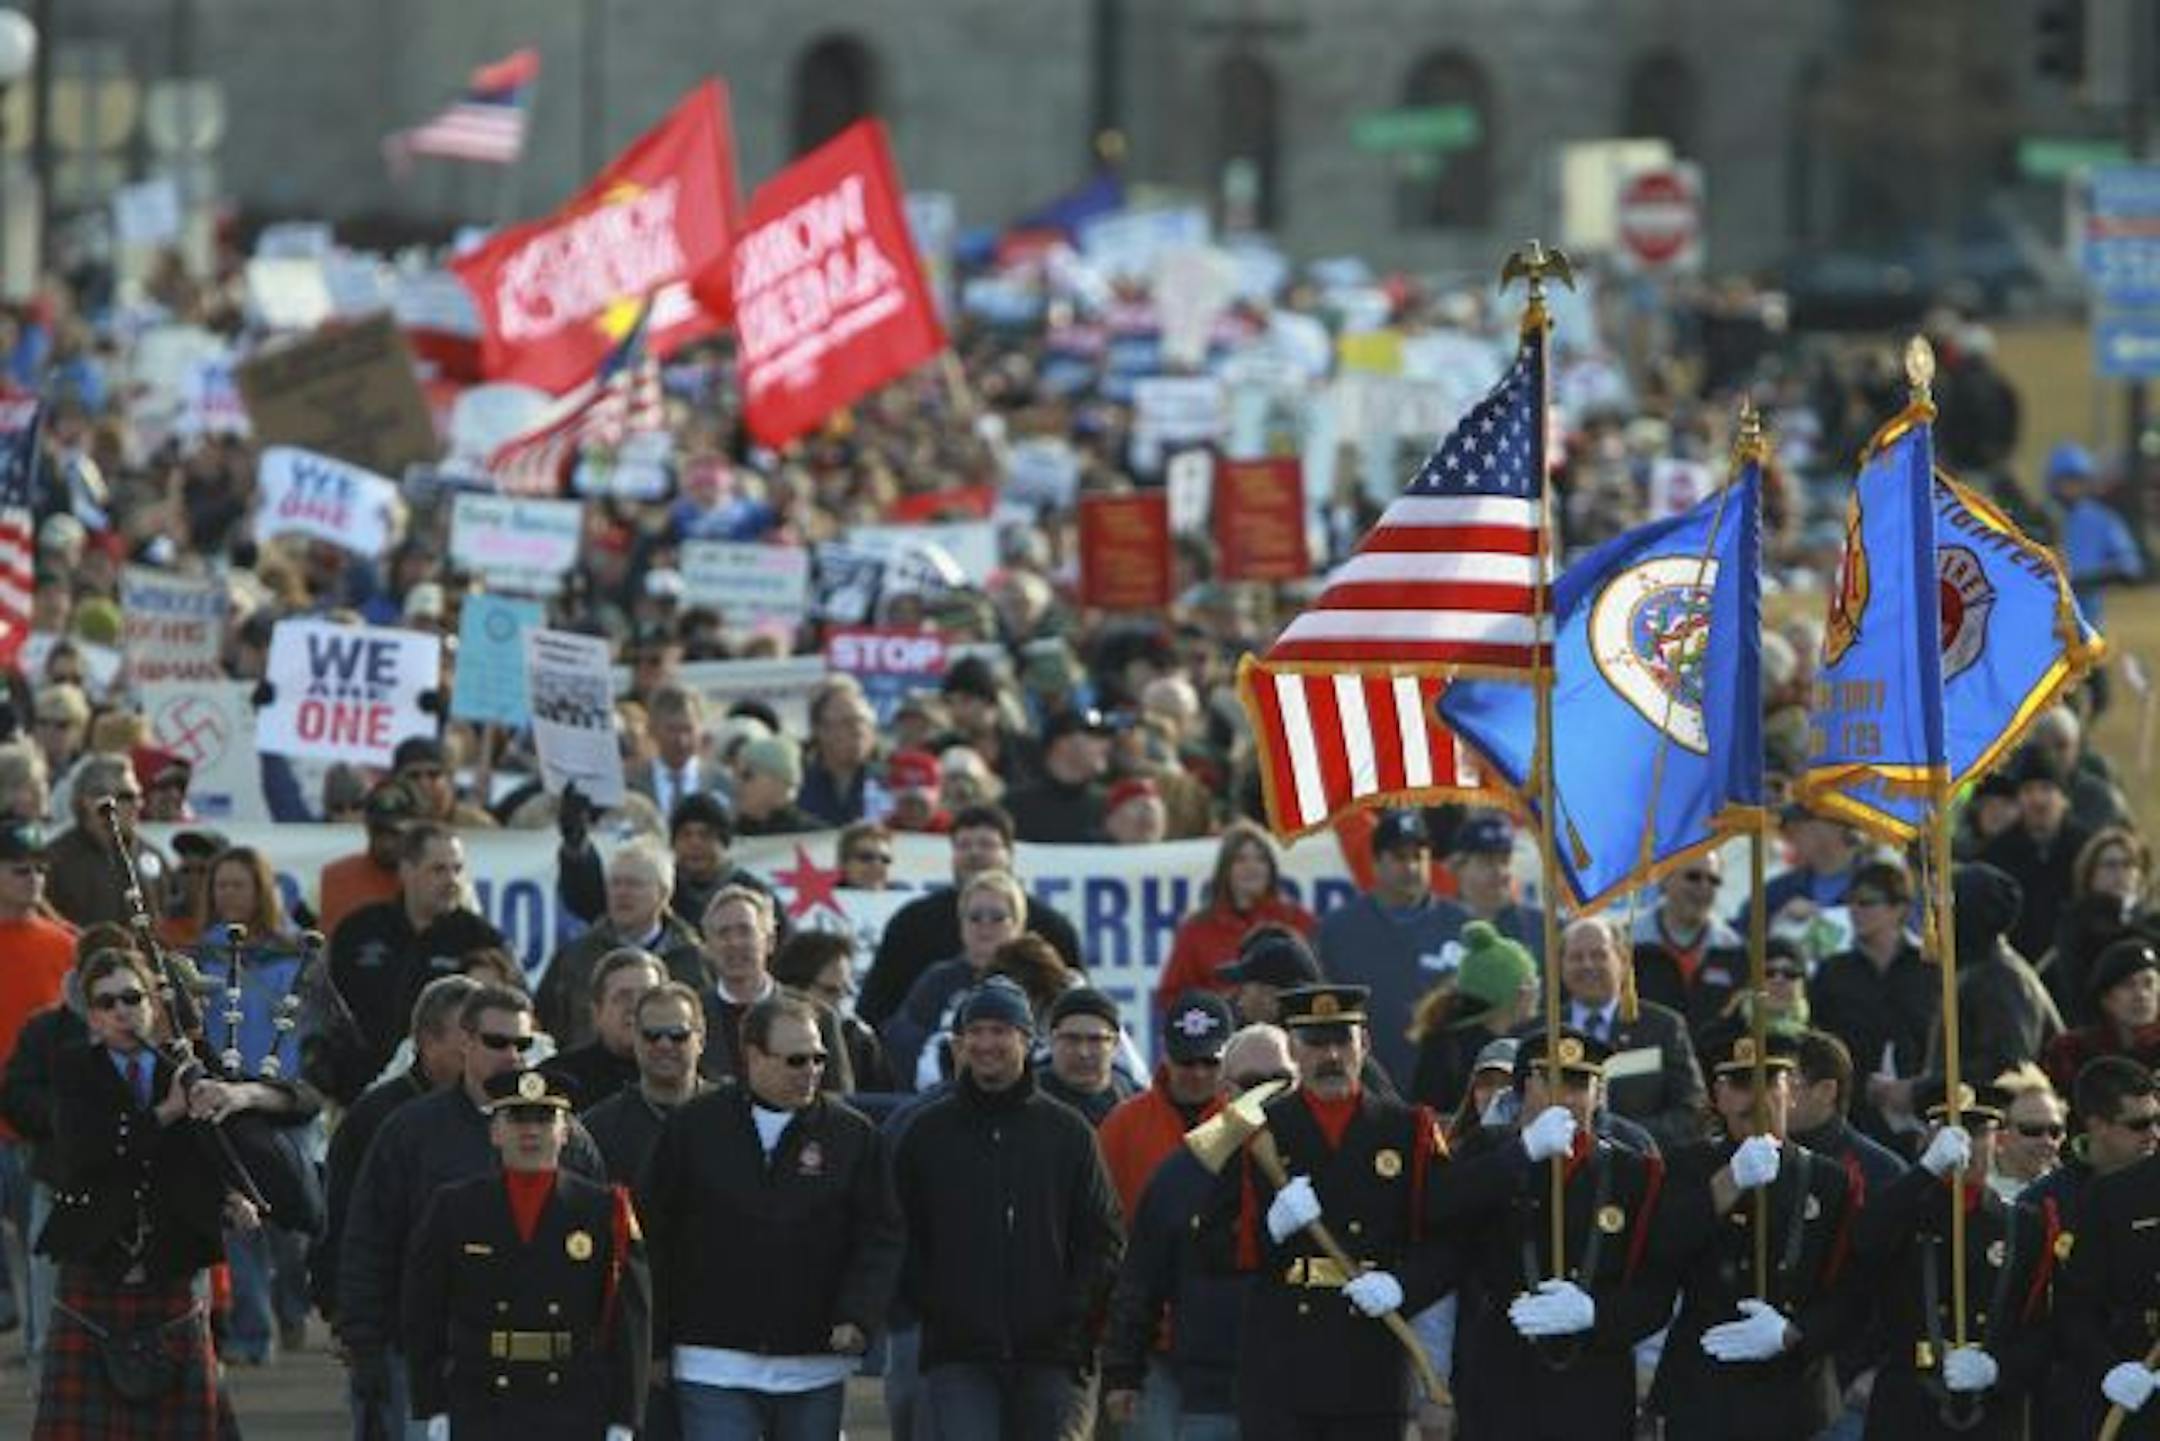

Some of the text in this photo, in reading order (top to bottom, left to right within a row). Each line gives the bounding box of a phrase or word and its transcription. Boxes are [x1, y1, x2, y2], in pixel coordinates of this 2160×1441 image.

[291, 460, 354, 496] WE
[1939, 554, 1983, 594] IRE
[306, 632, 402, 688] WE
[828, 636, 943, 668] STOP
[295, 700, 395, 750] ONE
